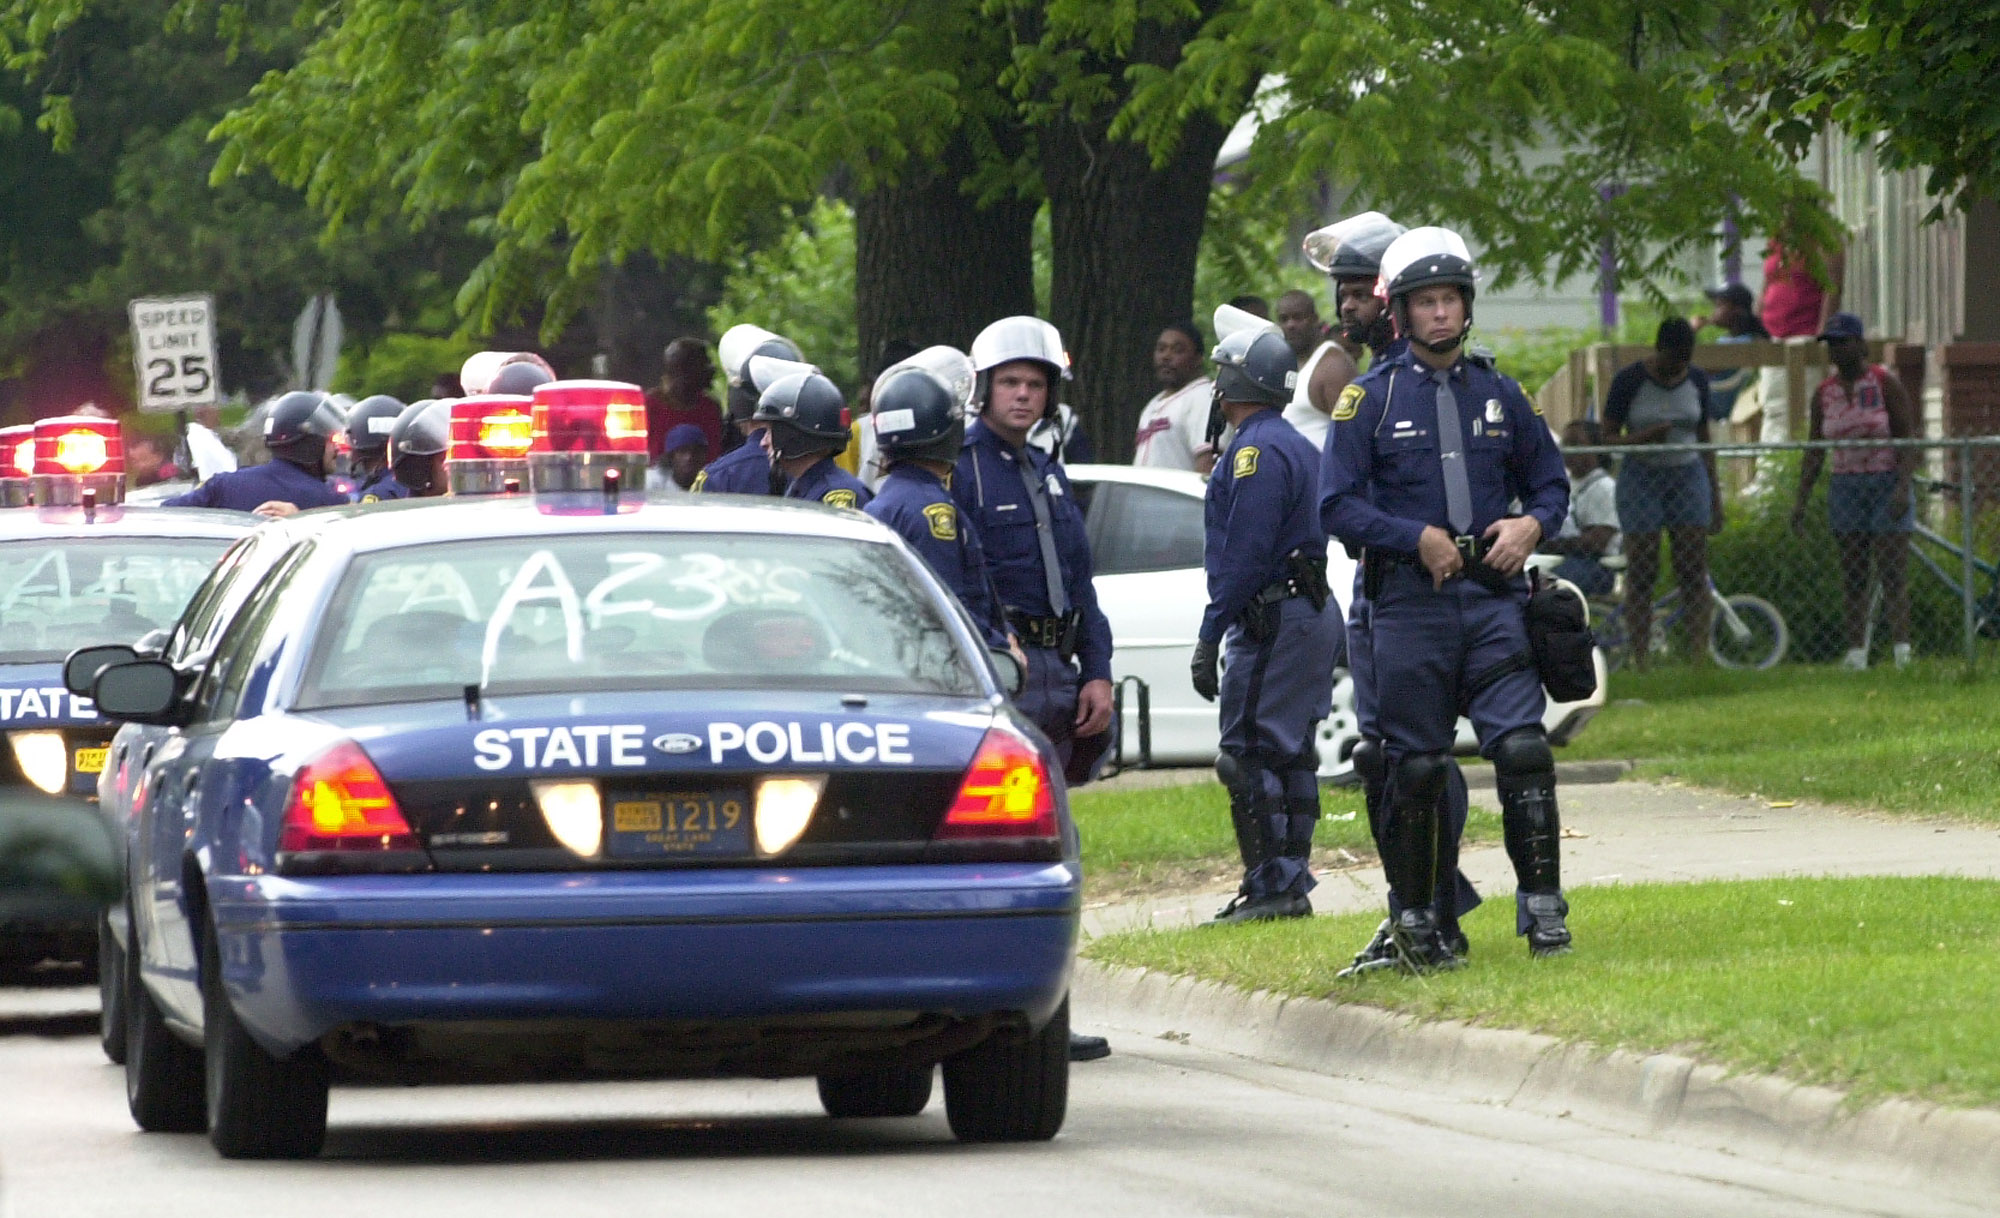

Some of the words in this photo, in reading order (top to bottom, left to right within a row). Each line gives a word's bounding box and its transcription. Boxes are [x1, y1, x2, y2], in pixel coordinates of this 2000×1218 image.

[141, 308, 205, 328] SPEED
[148, 332, 198, 350] LIMIT
[147, 355, 210, 396] 25
[481, 550, 728, 690] A23
[473, 724, 647, 770] STATE
[707, 722, 914, 764] POLICE
[665, 799, 742, 832] 1219
